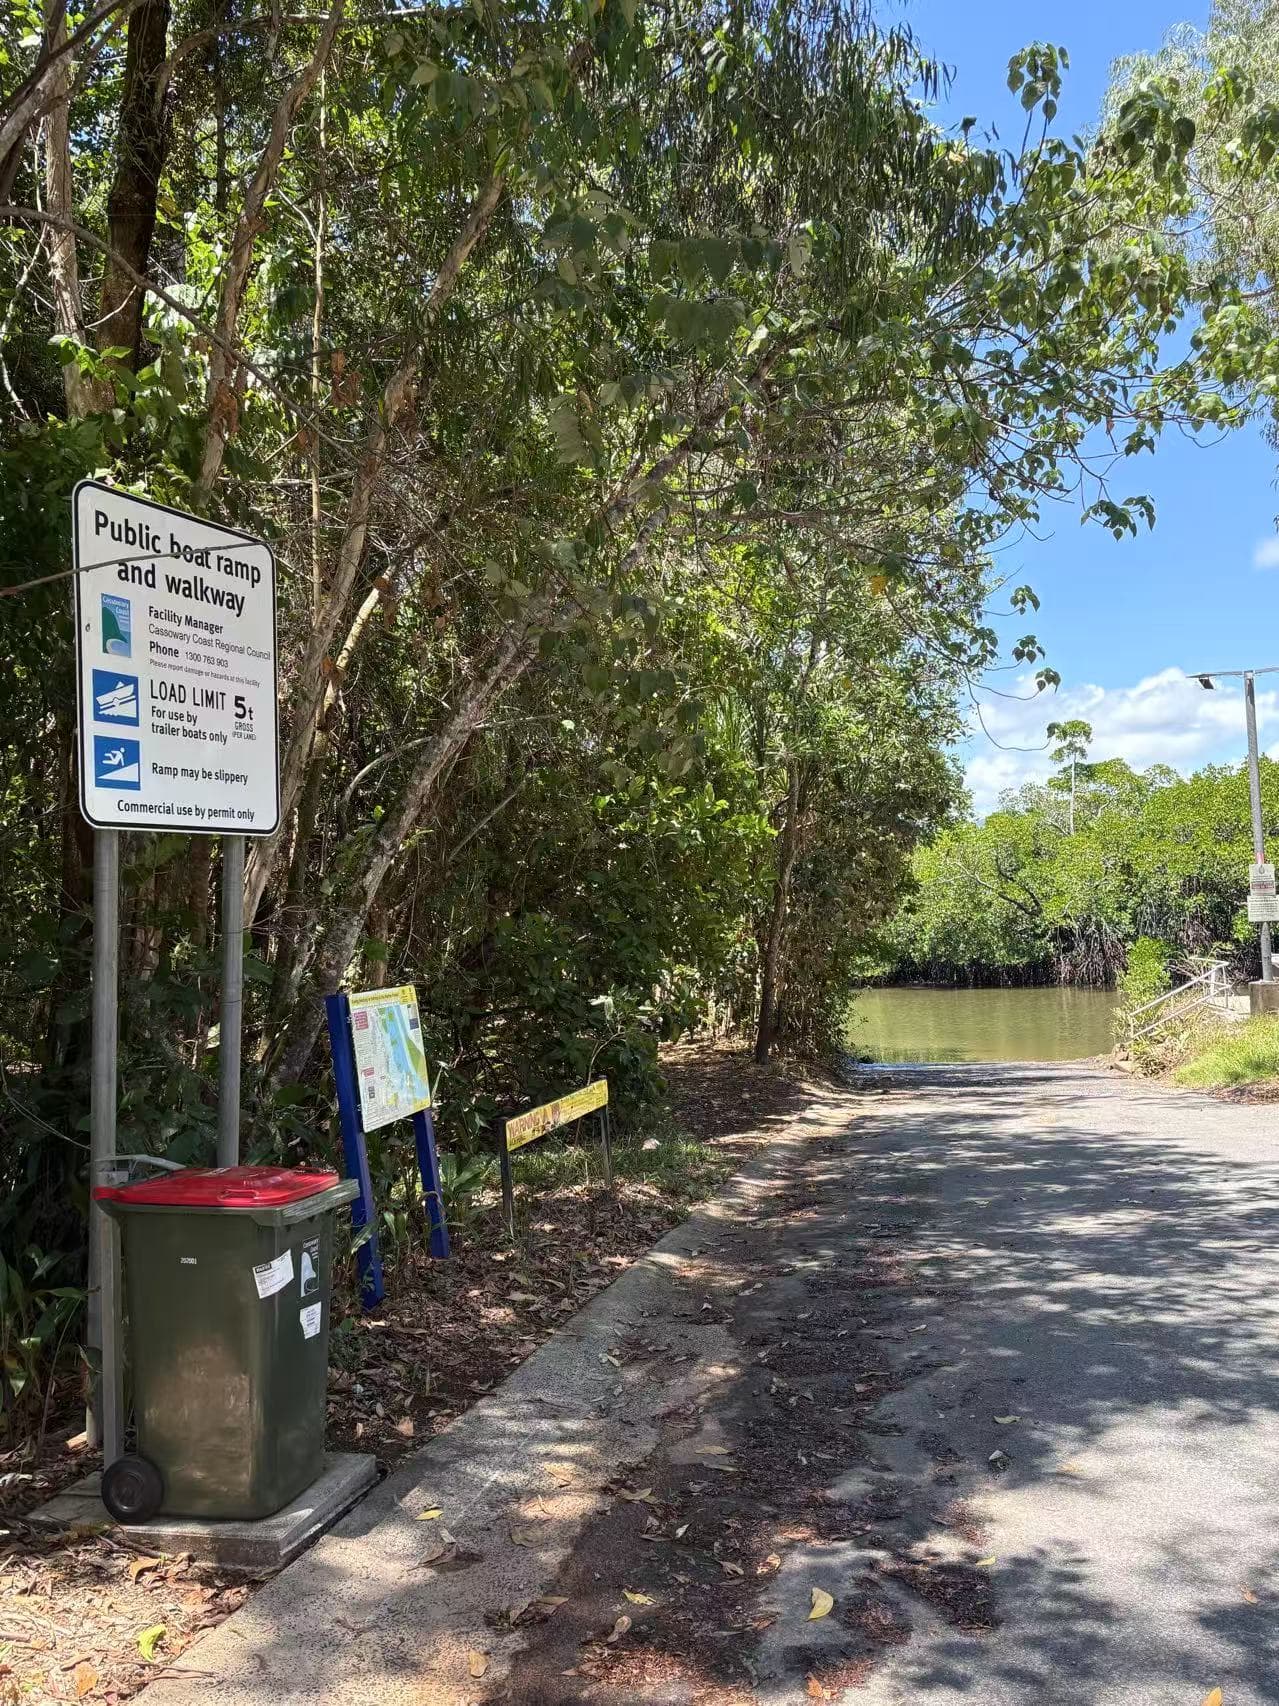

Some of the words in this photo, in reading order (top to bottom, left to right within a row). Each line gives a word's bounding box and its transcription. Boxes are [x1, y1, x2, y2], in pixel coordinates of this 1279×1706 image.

[95, 510, 161, 554] Public
[170, 533, 211, 569] boat
[217, 555, 261, 588] ramp
[118, 562, 156, 589] and
[165, 574, 245, 617] walkway
[149, 606, 182, 626] Facility
[185, 616, 223, 634] Manager
[149, 624, 191, 643] Cassowary
[192, 635, 213, 647] Coast
[216, 639, 245, 654] Regional
[247, 648, 270, 660] Council
[149, 641, 179, 657] Phone
[185, 651, 202, 661] 1300
[203, 655, 215, 665] 763
[217, 658, 228, 667] 903
[150, 659, 167, 668] Please
[184, 666, 204, 676] damage
[211, 671, 229, 680] hazards
[245, 679, 260, 687] facility
[150, 680, 186, 703] LOAD
[193, 687, 226, 710] LIMIT
[234, 696, 254, 720] 5t
[152, 706, 166, 718] For
[168, 711, 184, 721] use
[187, 711, 197, 725] by
[235, 722, 253, 732] GROSS
[152, 723, 180, 737] trailer
[182, 727, 207, 740] boats
[210, 731, 227, 745] only
[152, 763, 179, 778] Ramp
[181, 767, 199, 781] may
[202, 768, 212, 779] be
[215, 770, 248, 785] slippery
[118, 800, 174, 815] Commercial
[177, 805, 192, 815] use
[195, 805, 205, 818] by
[208, 806, 235, 819] permit
[237, 809, 255, 821] only
